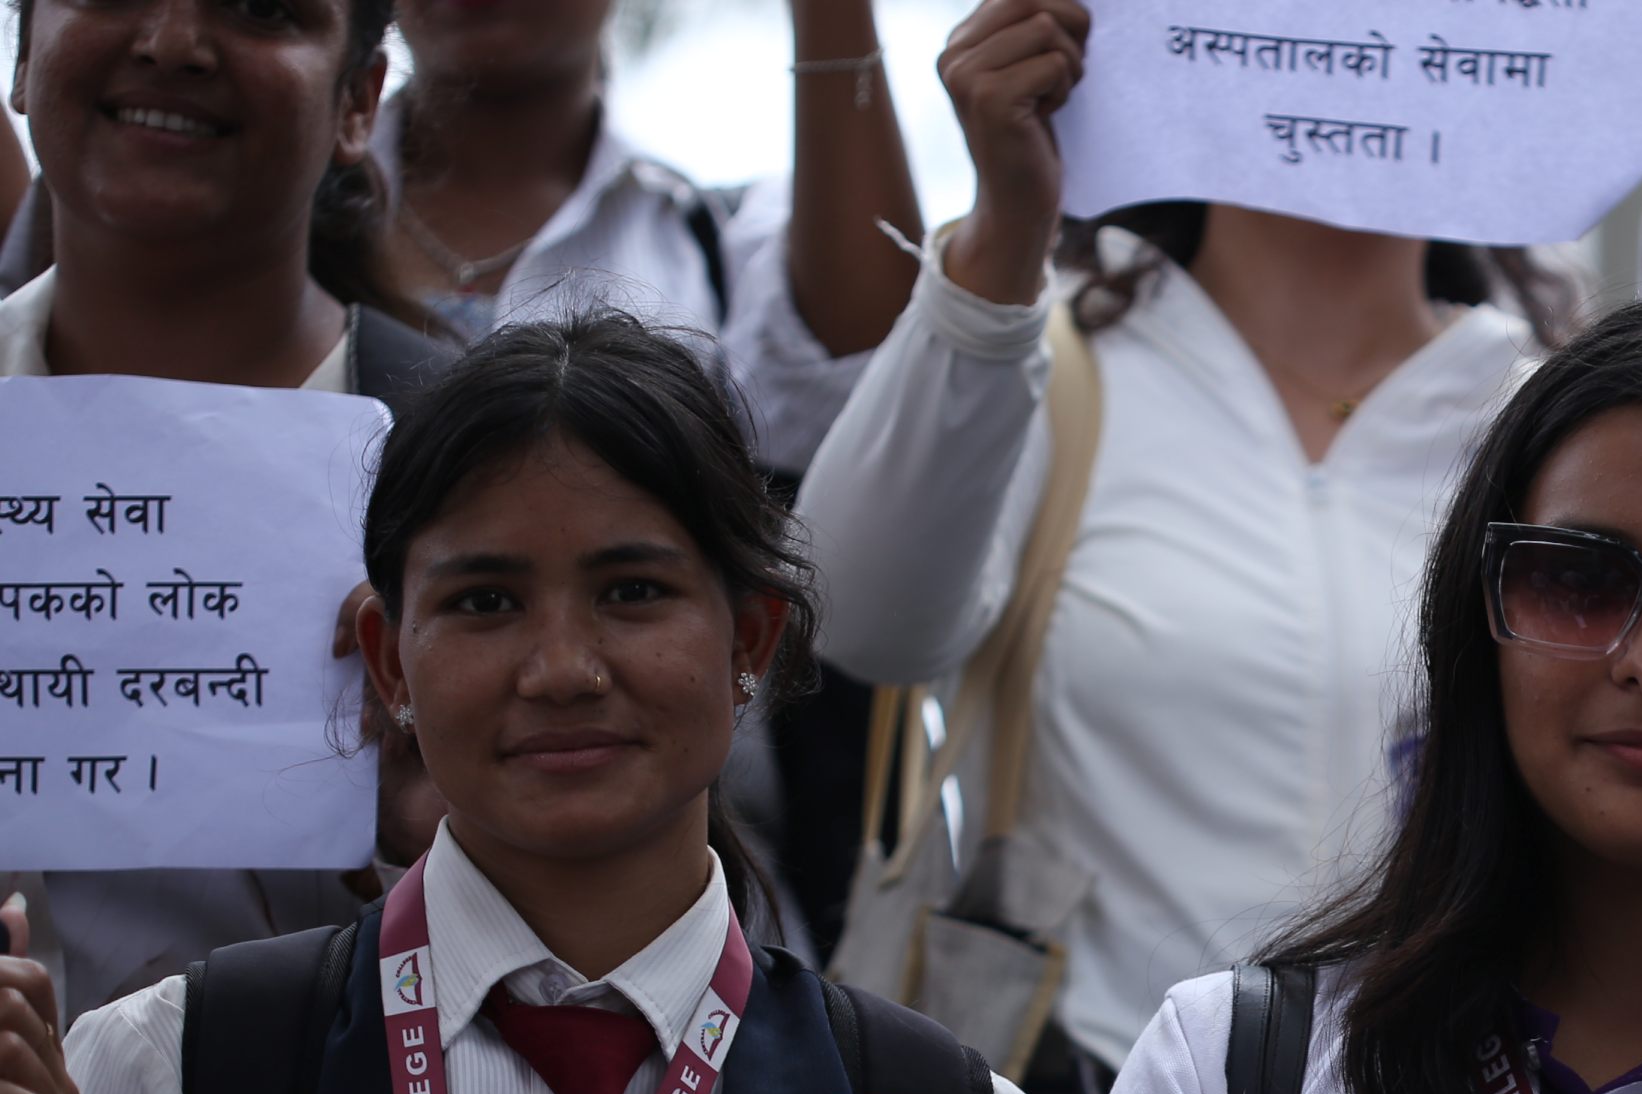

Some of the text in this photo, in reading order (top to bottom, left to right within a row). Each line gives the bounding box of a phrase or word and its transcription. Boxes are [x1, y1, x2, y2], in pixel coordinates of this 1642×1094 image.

[1167, 25, 1553, 87] अस्पतालको सेवामा
[1263, 113, 1410, 165] चुस्तता
[82, 482, 172, 535] सेवा
[145, 567, 243, 621] लोक
[115, 652, 270, 708] दरबन्दी
[66, 755, 128, 794] गर
